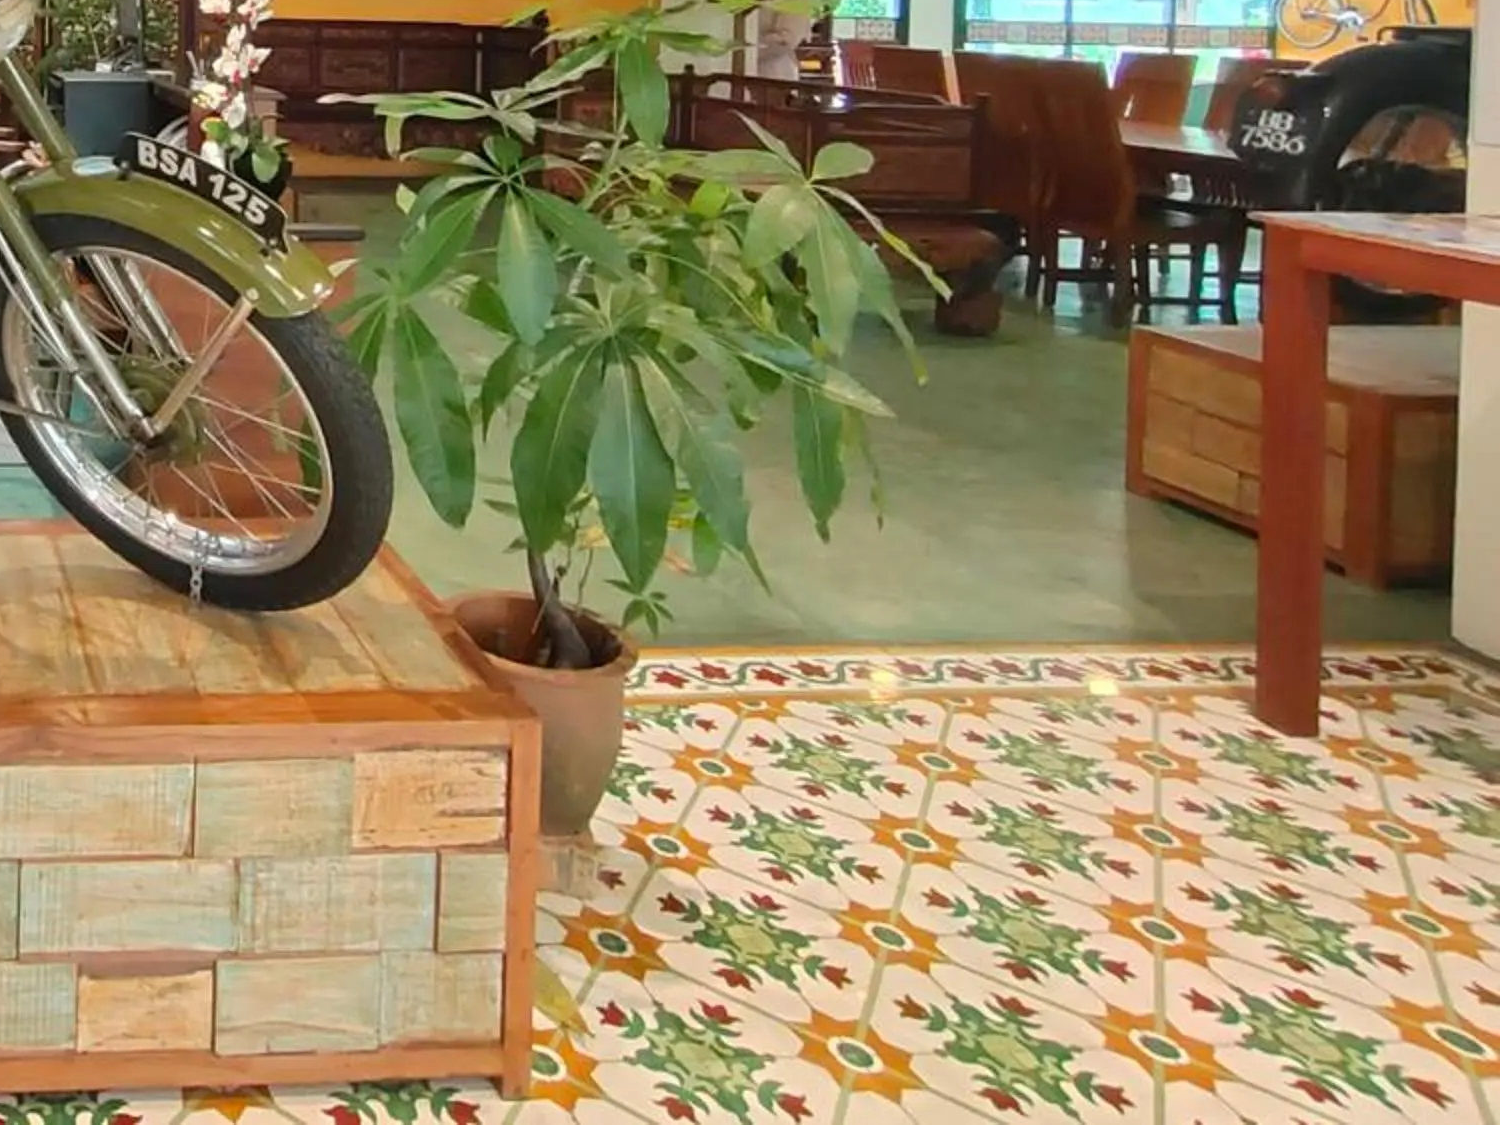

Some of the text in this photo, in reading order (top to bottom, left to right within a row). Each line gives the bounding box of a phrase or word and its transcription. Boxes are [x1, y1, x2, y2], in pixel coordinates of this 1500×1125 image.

[1241, 125, 1306, 155] 7586
[136, 140, 270, 226] BSA 125
